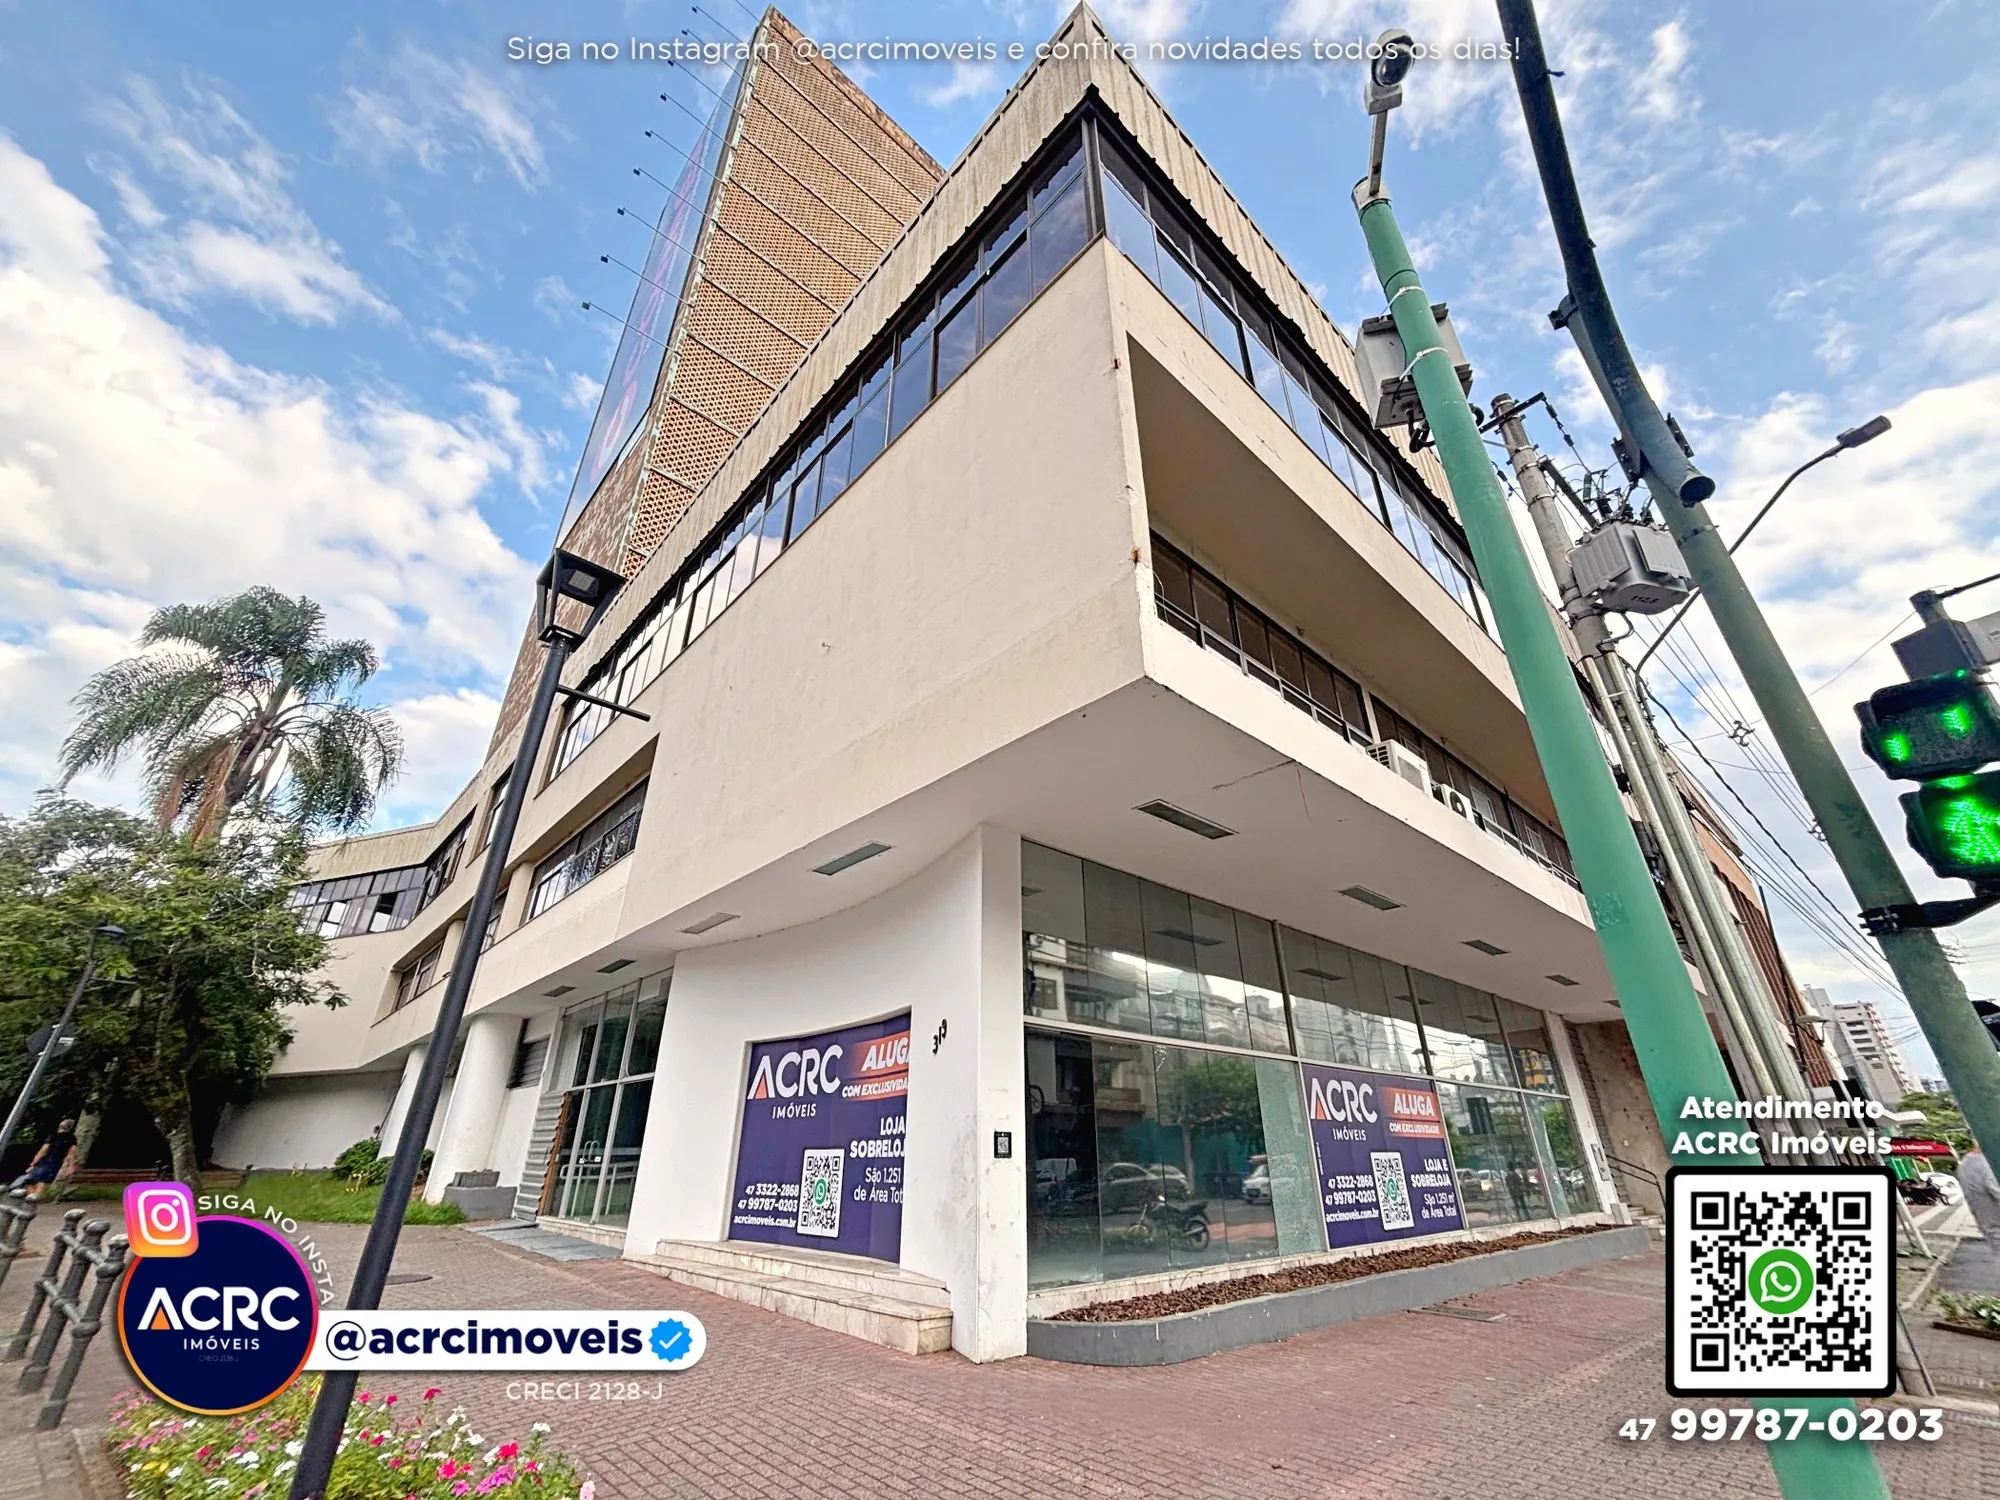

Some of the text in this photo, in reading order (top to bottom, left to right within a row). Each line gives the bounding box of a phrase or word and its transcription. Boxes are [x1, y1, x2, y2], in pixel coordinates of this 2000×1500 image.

[747, 1044, 844, 1100] ACRC
[842, 1084, 861, 1098] COM
[1310, 1077, 1378, 1124] ACRC
[1394, 1092, 1435, 1116] ALUGA
[772, 1103, 817, 1120] IMÓVEIS
[880, 1115, 906, 1136] LOJA
[1389, 1122, 1401, 1133] COM
[1332, 1126, 1367, 1141] IMÓVEIS
[1423, 1158, 1449, 1171] LOJA E
[865, 1167, 882, 1183] São
[1410, 1173, 1452, 1188] SOBRELOJA
[745, 1183, 800, 1197] 47 3322-2868
[1328, 1178, 1336, 1189] 47
[853, 1184, 867, 1201] de
[869, 1182, 888, 1203] Área
[1325, 1189, 1377, 1205] 47 99787-0203
[737, 1197, 799, 1212] 47 99787-0203
[1443, 1204, 1457, 1217] Total
[733, 1214, 797, 1229] acrcimoveis.com.br
[1326, 1207, 1380, 1223] acrcimoveis.com.br
